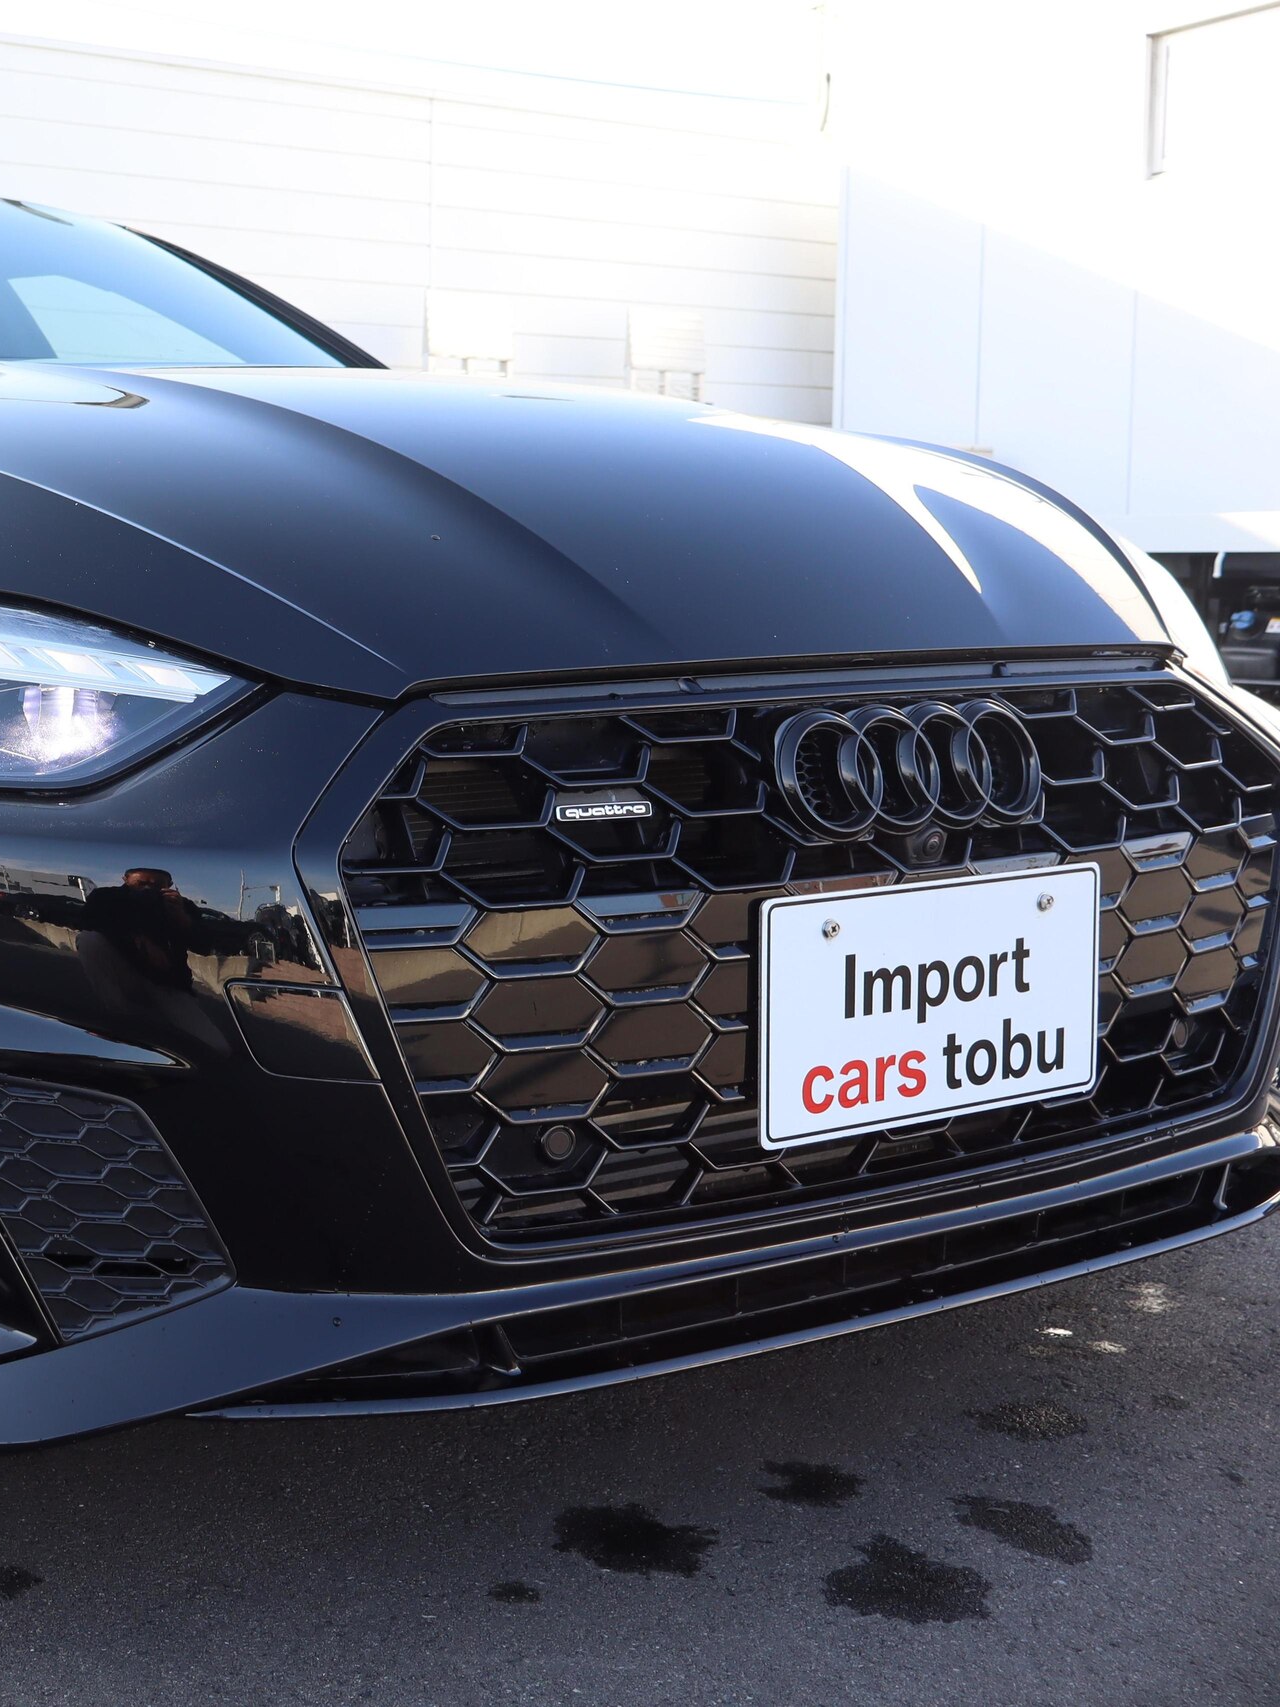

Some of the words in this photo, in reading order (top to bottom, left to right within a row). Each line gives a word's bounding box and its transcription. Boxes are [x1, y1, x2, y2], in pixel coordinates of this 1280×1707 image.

[565, 804, 646, 819] quattro
[844, 938, 1030, 1024] Import
[802, 1050, 927, 1114] cars
[942, 1017, 1065, 1091] tobu
